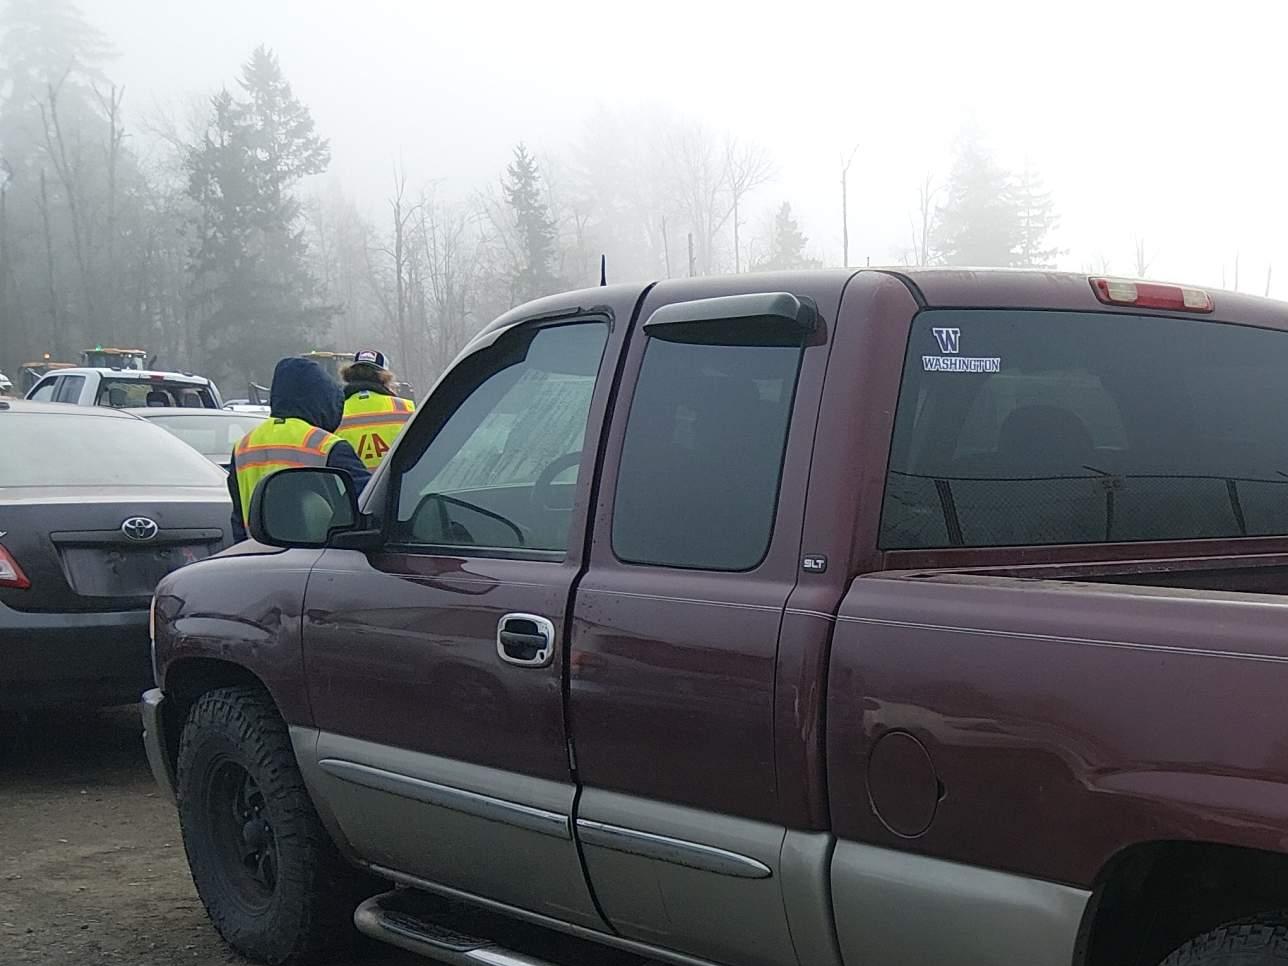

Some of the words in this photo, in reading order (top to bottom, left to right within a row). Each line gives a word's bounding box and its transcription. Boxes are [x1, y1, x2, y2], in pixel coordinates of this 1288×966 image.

[933, 327, 960, 353] W
[922, 355, 1000, 373] WASHINGTON
[803, 558, 825, 569] SLT
